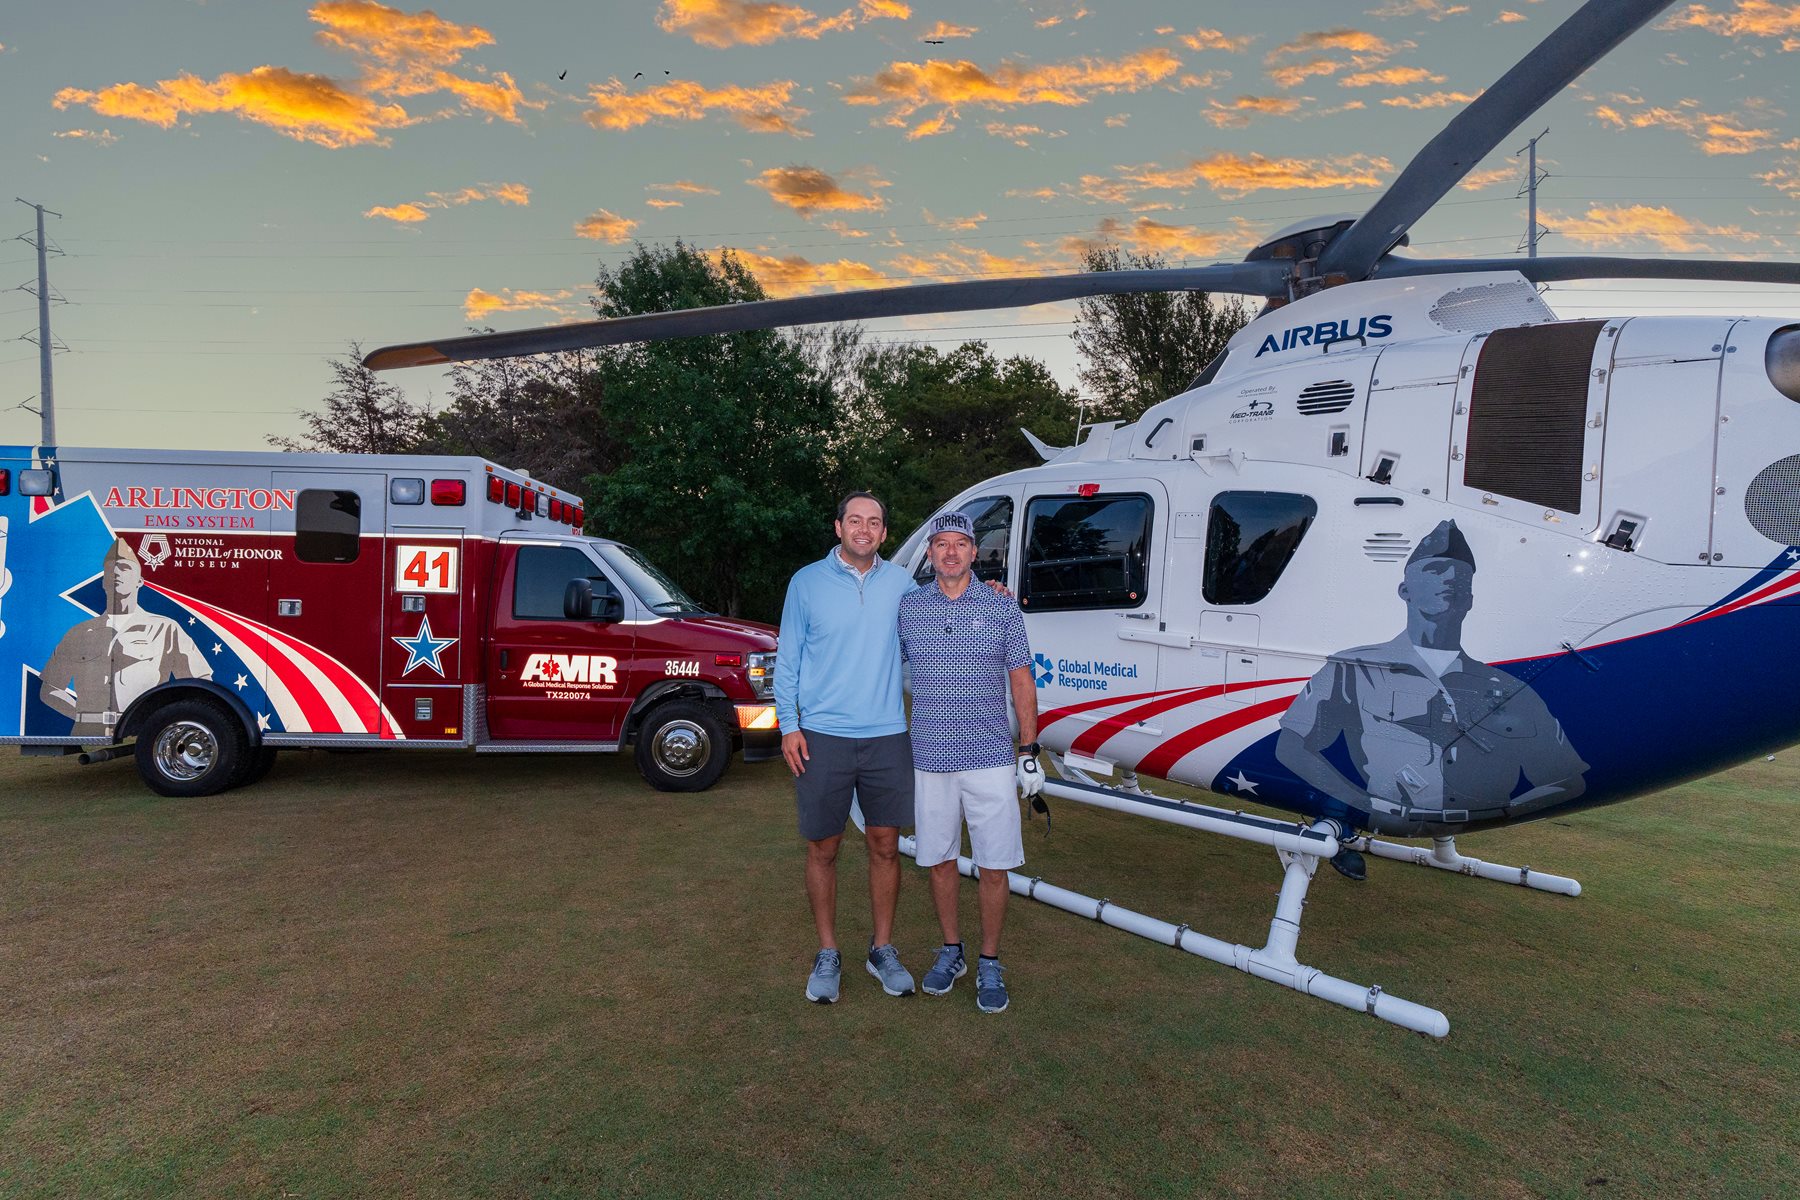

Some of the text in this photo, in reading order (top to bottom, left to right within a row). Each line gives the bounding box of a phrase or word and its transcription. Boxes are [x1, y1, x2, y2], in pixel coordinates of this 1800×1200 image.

[1254, 315, 1393, 358] AIRBUS
[1240, 387, 1267, 395] Operated
[103, 486, 297, 511] ARLINGTON
[144, 515, 255, 528] EMS SYSTEM
[935, 514, 968, 530] TORREY
[174, 538, 225, 546] NATIONAL
[174, 547, 283, 560] MEDAL of HONOR
[174, 560, 240, 568] MUSEUM
[404, 551, 449, 588] 41
[520, 653, 618, 683] AMR
[665, 660, 700, 677] 35444
[1058, 659, 1138, 678] Global Medical
[1058, 673, 1108, 691] Response
[546, 691, 591, 700] TX220074
